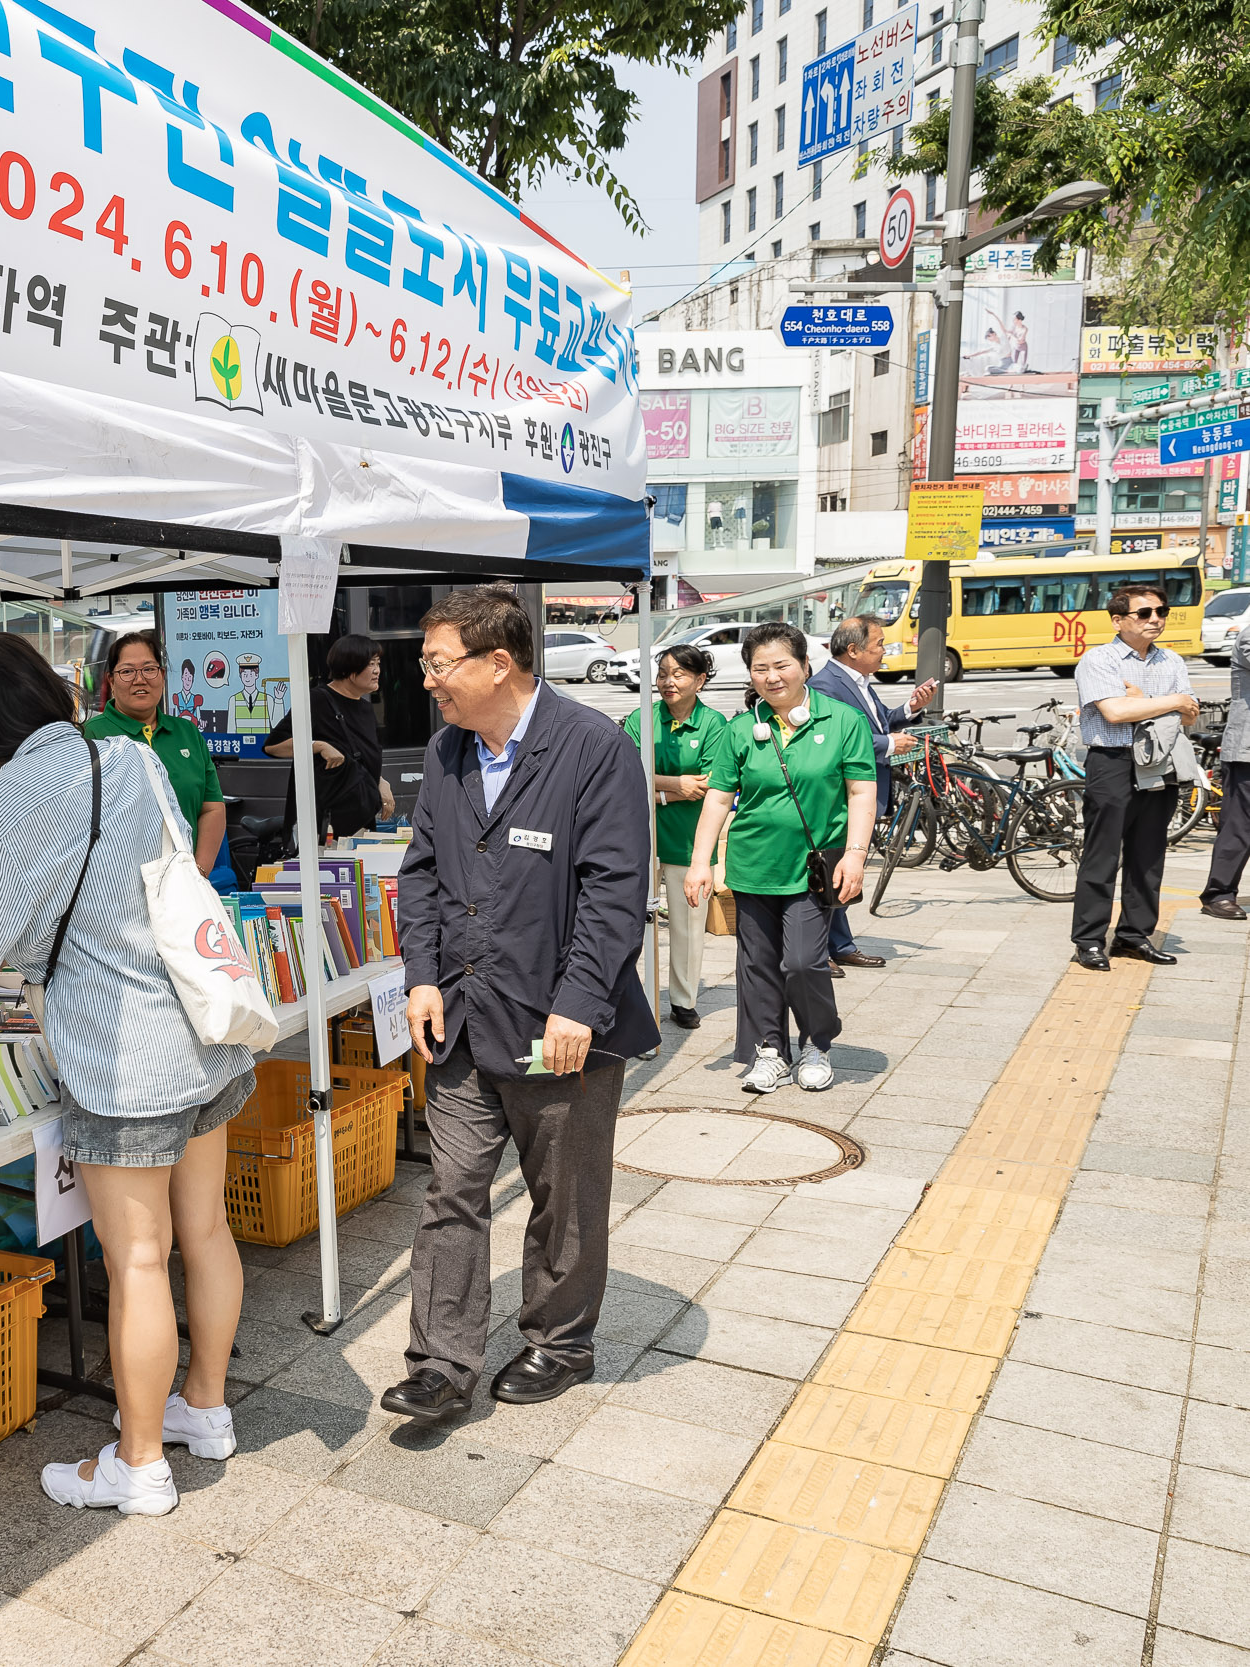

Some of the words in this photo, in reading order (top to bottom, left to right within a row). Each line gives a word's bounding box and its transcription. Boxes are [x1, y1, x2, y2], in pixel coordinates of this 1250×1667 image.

[856, 19, 914, 64] 노선버스
[804, 66, 818, 82] 1차로
[821, 58, 837, 73] 2차로
[887, 209, 908, 247] 50
[812, 308, 868, 323] 천호대로
[784, 320, 803, 331] 554
[804, 324, 870, 334] Cheonho-daero
[871, 320, 890, 331] 558
[658, 347, 744, 374] BANG
[99, 297, 194, 380] 주관:
[263, 352, 513, 450] 새마을문고광진구지부
[524, 417, 559, 461] 후원:
[578, 430, 612, 470] 광진구
[640, 395, 687, 411] SALE
[1205, 408, 1237, 422] 아차산역
[715, 424, 735, 434] BIG
[739, 423, 765, 434] SIZE
[770, 422, 793, 434] 전문
[1017, 422, 1066, 438] 필라테스
[1202, 424, 1233, 443] 능동로
[1192, 438, 1243, 456] Neungdong-ro
[1051, 454, 1066, 465] 2F
[1035, 480, 1072, 495] 마사지
[1222, 480, 1237, 510] 바둑
[176, 607, 197, 620] 가족의
[199, 604, 220, 620] 행복
[223, 604, 260, 618] 입니다.
[240, 630, 264, 639] 자전거
[1054, 612, 1087, 657] DYB
